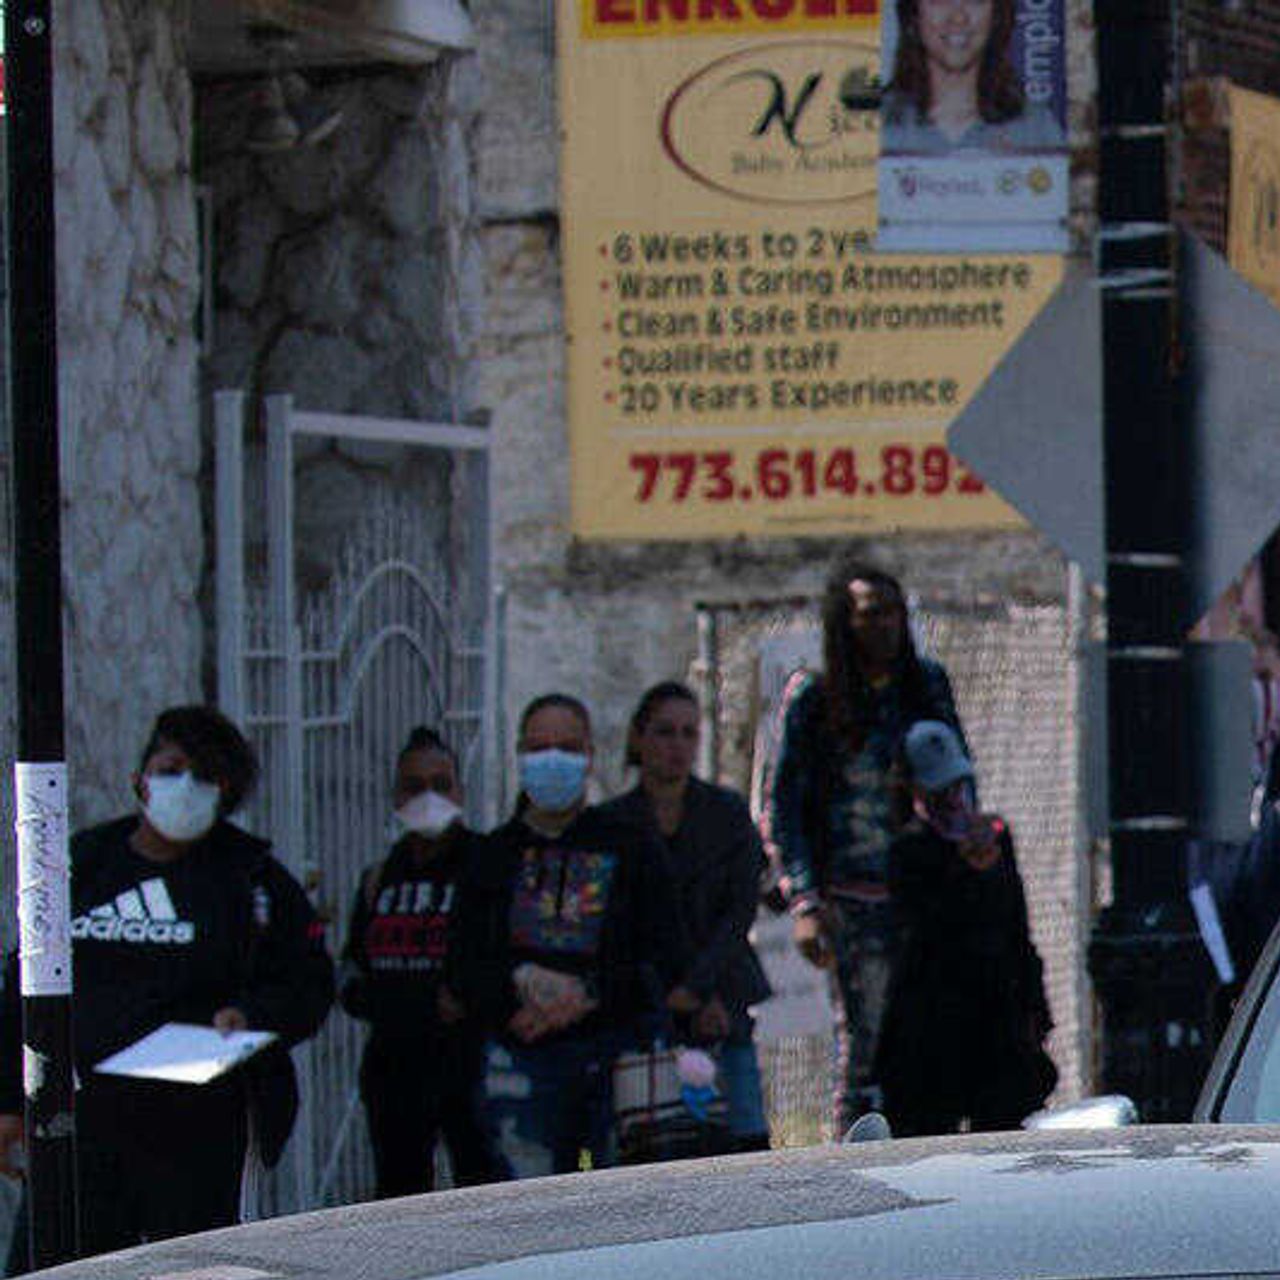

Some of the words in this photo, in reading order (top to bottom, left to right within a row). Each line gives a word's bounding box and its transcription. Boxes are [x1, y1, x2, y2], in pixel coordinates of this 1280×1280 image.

[612, 234, 632, 263] 6
[640, 231, 750, 262] Weeks
[760, 229, 799, 259] to
[807, 231, 825, 258] 2
[616, 273, 703, 301] Warm
[711, 269, 729, 298] &
[738, 267, 835, 297] Caring
[842, 261, 1031, 293] Atmosphere
[617, 310, 699, 338] Clean
[706, 308, 724, 336] &
[729, 307, 797, 336] Safe
[805, 301, 1004, 332] Environment
[617, 344, 753, 375] Qualified
[763, 343, 839, 371] staff
[619, 383, 660, 414] 20
[668, 381, 760, 411] Years
[771, 376, 960, 409] Experience
[70, 914, 194, 944] adidas
